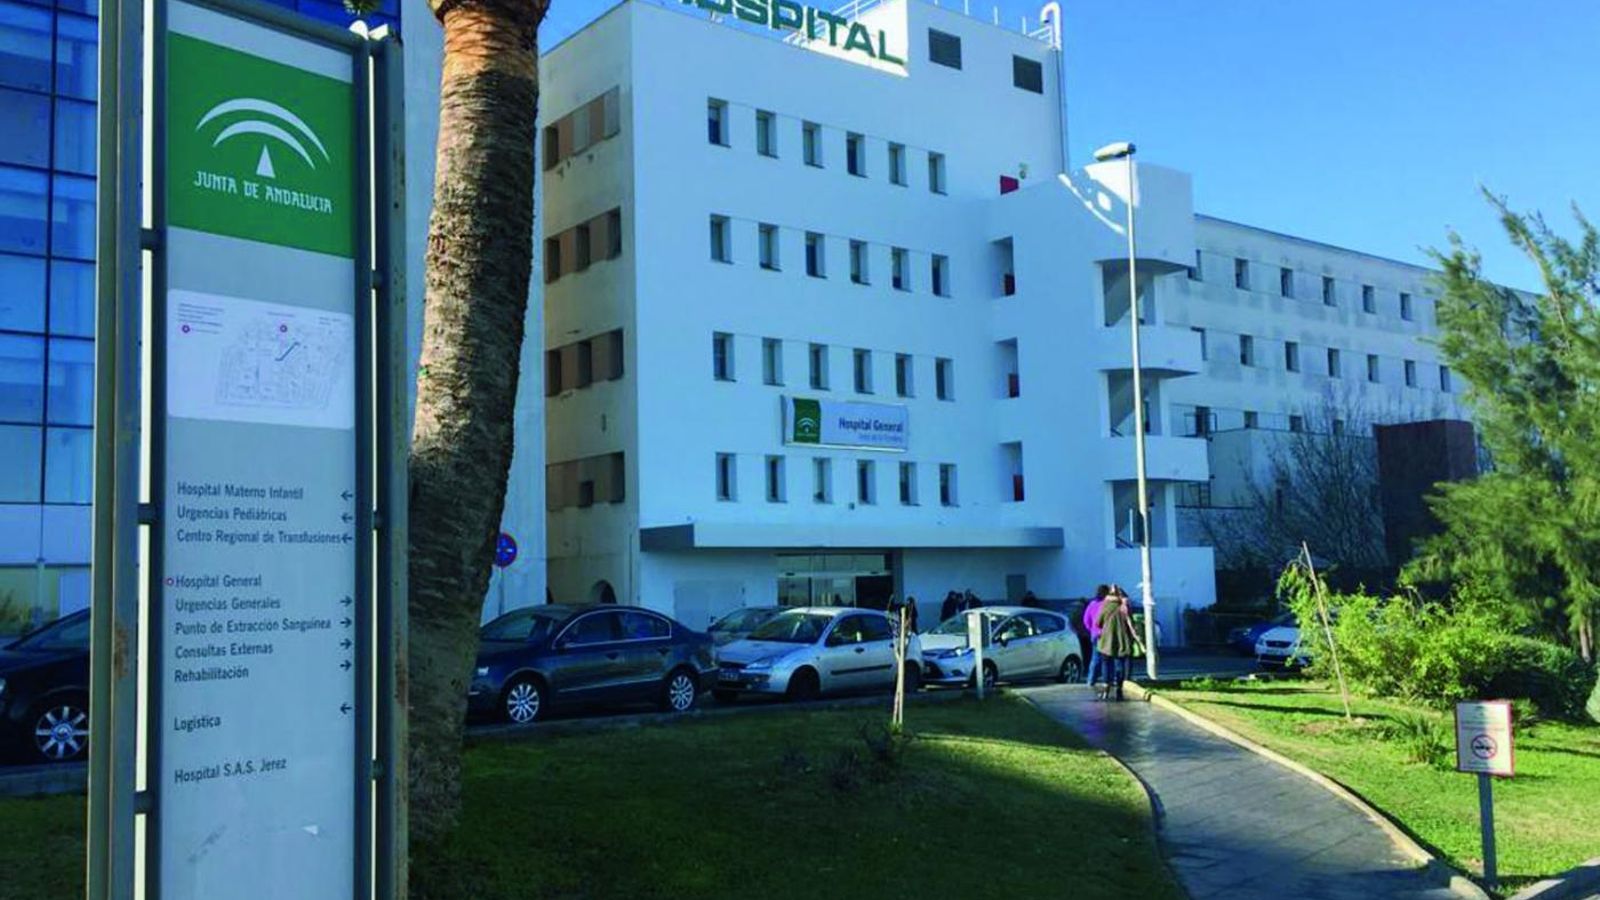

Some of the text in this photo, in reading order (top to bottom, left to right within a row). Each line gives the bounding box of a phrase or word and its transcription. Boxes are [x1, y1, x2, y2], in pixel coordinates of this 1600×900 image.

[676, 0, 906, 66] SPITAL
[194, 170, 238, 194] JUNTA
[243, 180, 259, 199] DE
[838, 416, 872, 432] Hospital
[177, 481, 304, 500] Hospital Materno Infantil
[177, 505, 229, 522] Urgencias
[177, 528, 341, 545] Centro Regional de Transfusiones
[176, 574, 262, 590] Hospital General
[175, 596, 281, 613] Urgencias Generales
[175, 622, 207, 635] Punto
[210, 620, 223, 634] de
[175, 642, 273, 659] Consultas Externas
[174, 666, 249, 683] Rehabilitación
[174, 757, 287, 783] Hospital S.A.S. Jerez
